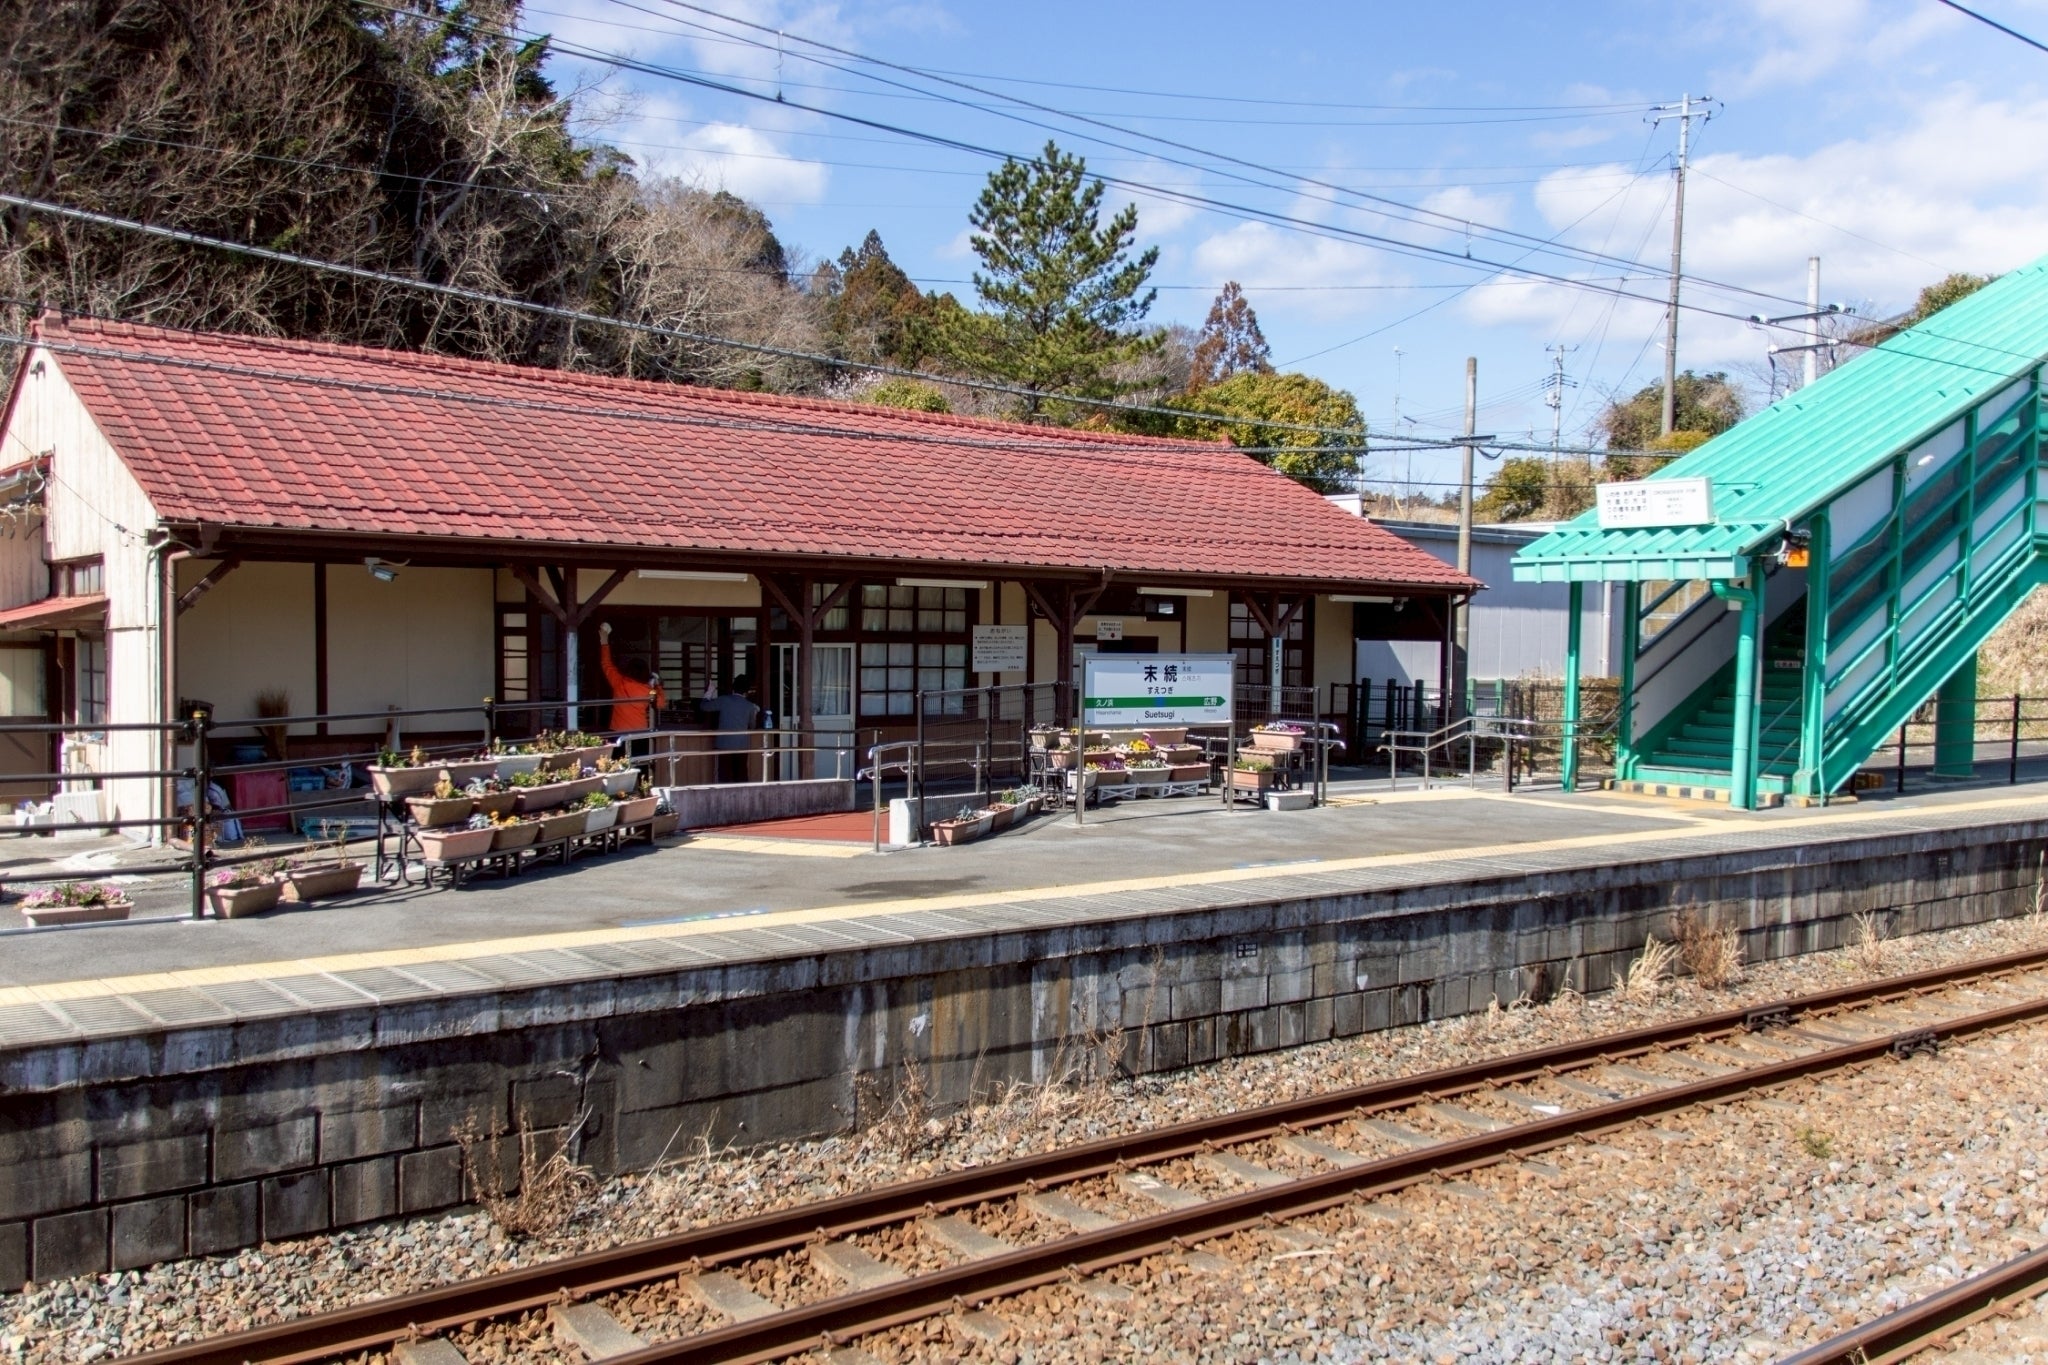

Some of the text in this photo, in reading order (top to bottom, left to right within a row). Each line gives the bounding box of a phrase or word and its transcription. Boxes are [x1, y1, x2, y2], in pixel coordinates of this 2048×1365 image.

[1144, 664, 1178, 683] 末続
[1147, 686, 1174, 695] すえつぎ
[1144, 710, 1175, 720] Suetsugi
